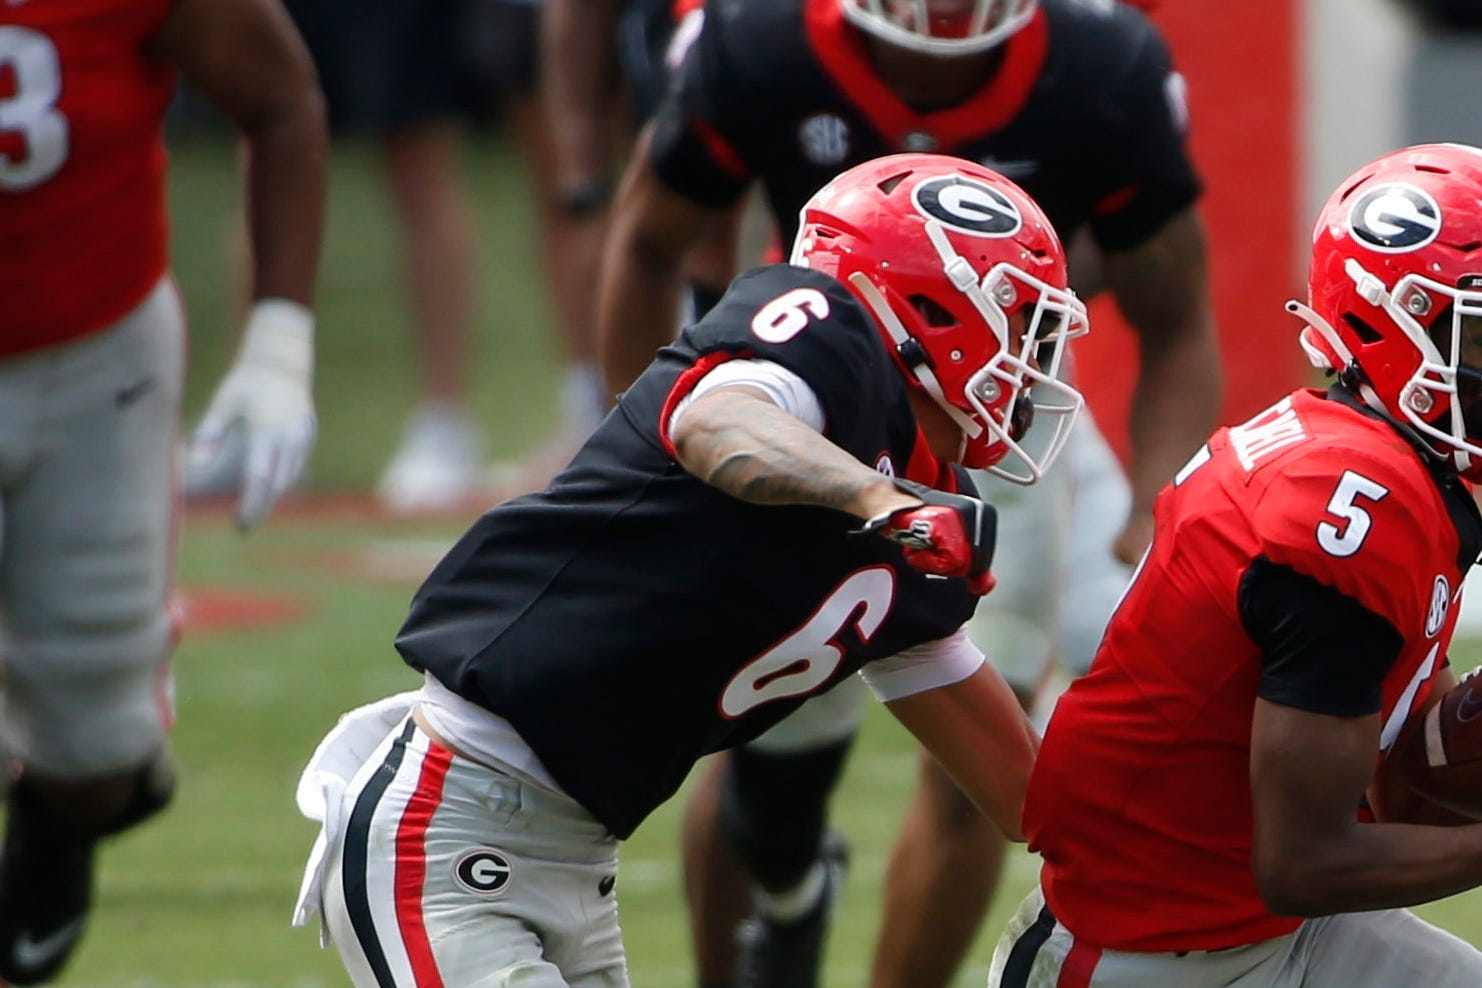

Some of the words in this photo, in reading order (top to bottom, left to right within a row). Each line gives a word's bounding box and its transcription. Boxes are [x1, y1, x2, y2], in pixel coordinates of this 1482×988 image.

[913, 176, 1021, 236] G
[1350, 183, 1441, 251] G
[751, 287, 830, 344] 6
[1316, 469, 1391, 557] 5
[718, 563, 897, 721] 6
[455, 851, 512, 893] G
